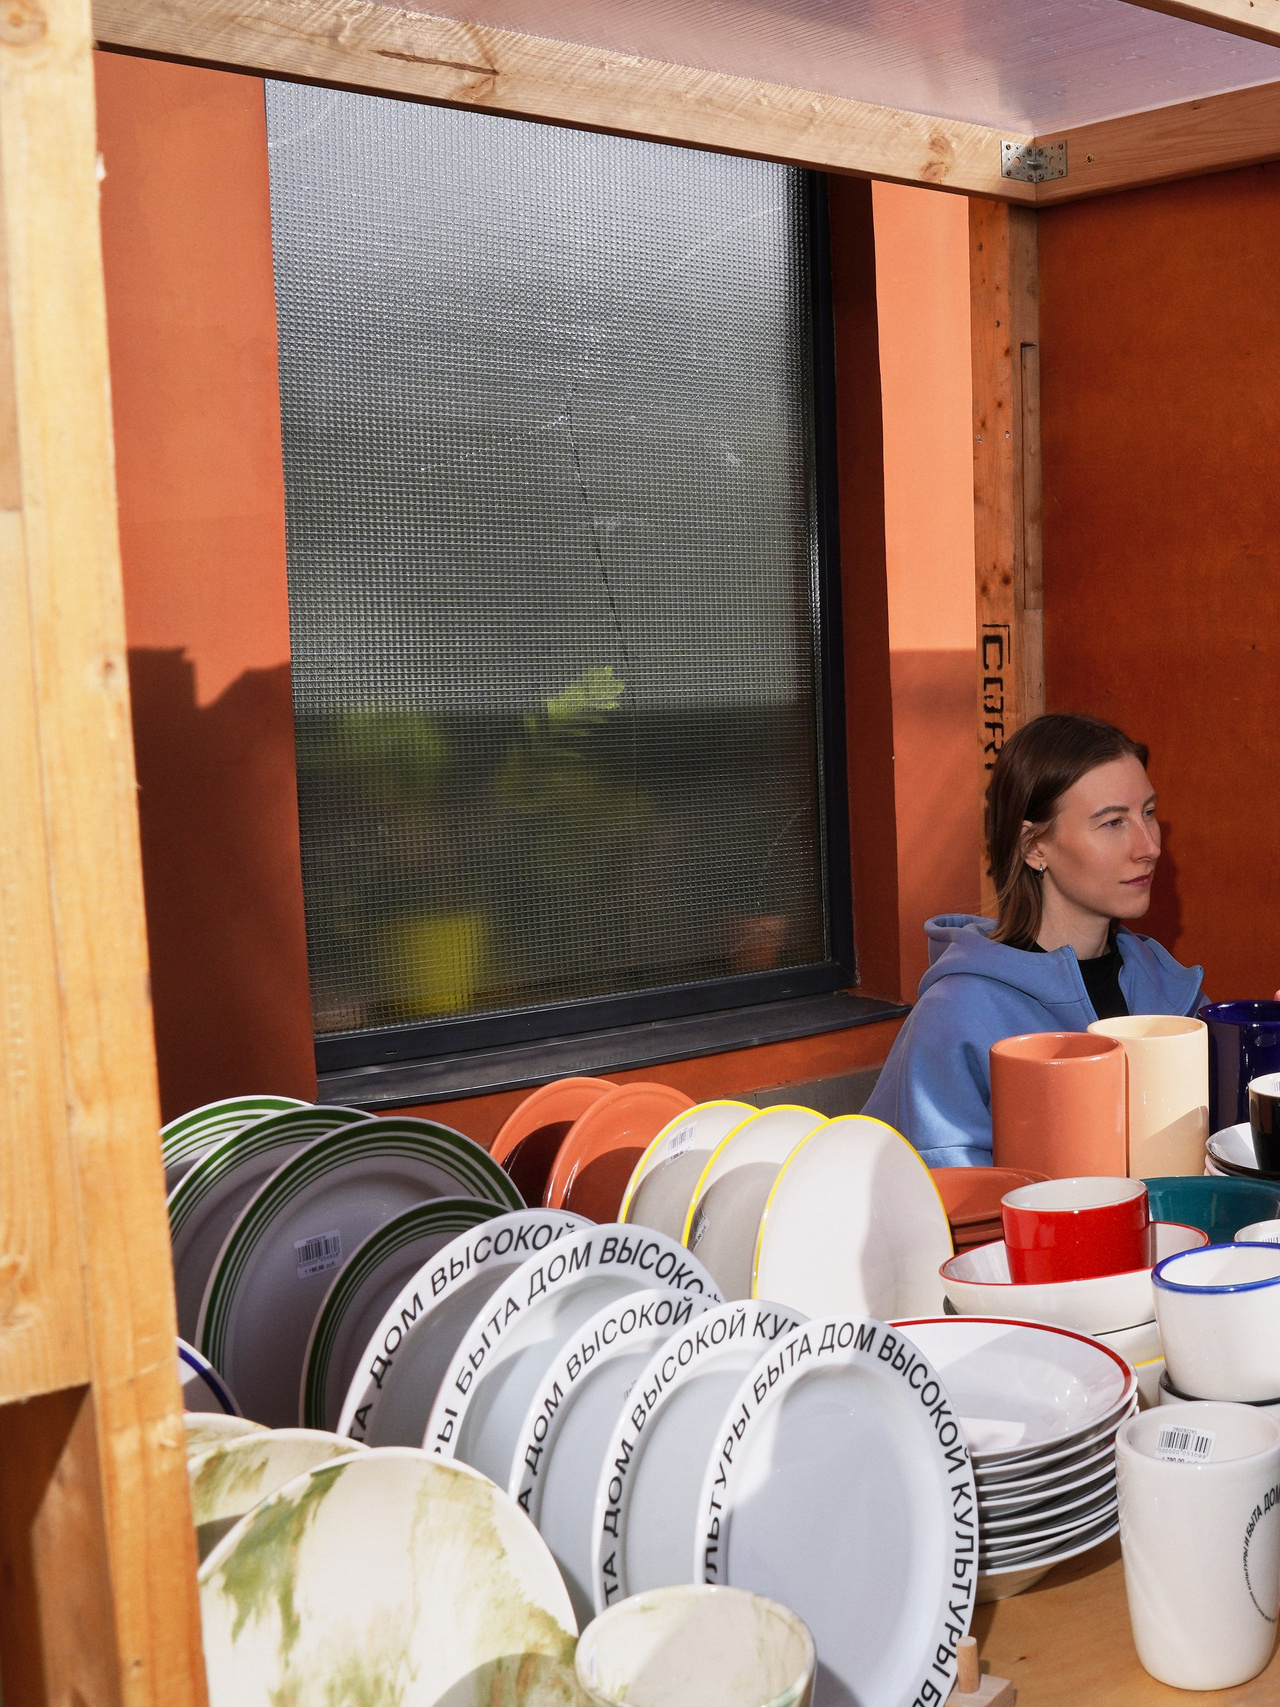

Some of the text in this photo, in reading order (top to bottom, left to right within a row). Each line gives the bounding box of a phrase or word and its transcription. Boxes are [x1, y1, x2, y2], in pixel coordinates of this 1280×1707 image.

[983, 635, 1004, 770] COR
[370, 1293, 424, 1389] ДОМ
[455, 1236, 721, 1395] БЫТА ДОМ ВЫСОКО
[524, 1296, 694, 1476] ДОМ ВЫСОКОЙ
[603, 1439, 634, 1538] ДОМ
[631, 1307, 747, 1432] ВЫСОКОЙ
[705, 1322, 974, 1678] ЛЬТУРЫ БЫТА ДОМ ВЫСОКОЙ КУЛЬТУРЫ
[1246, 1504, 1262, 1538] БЫТА
